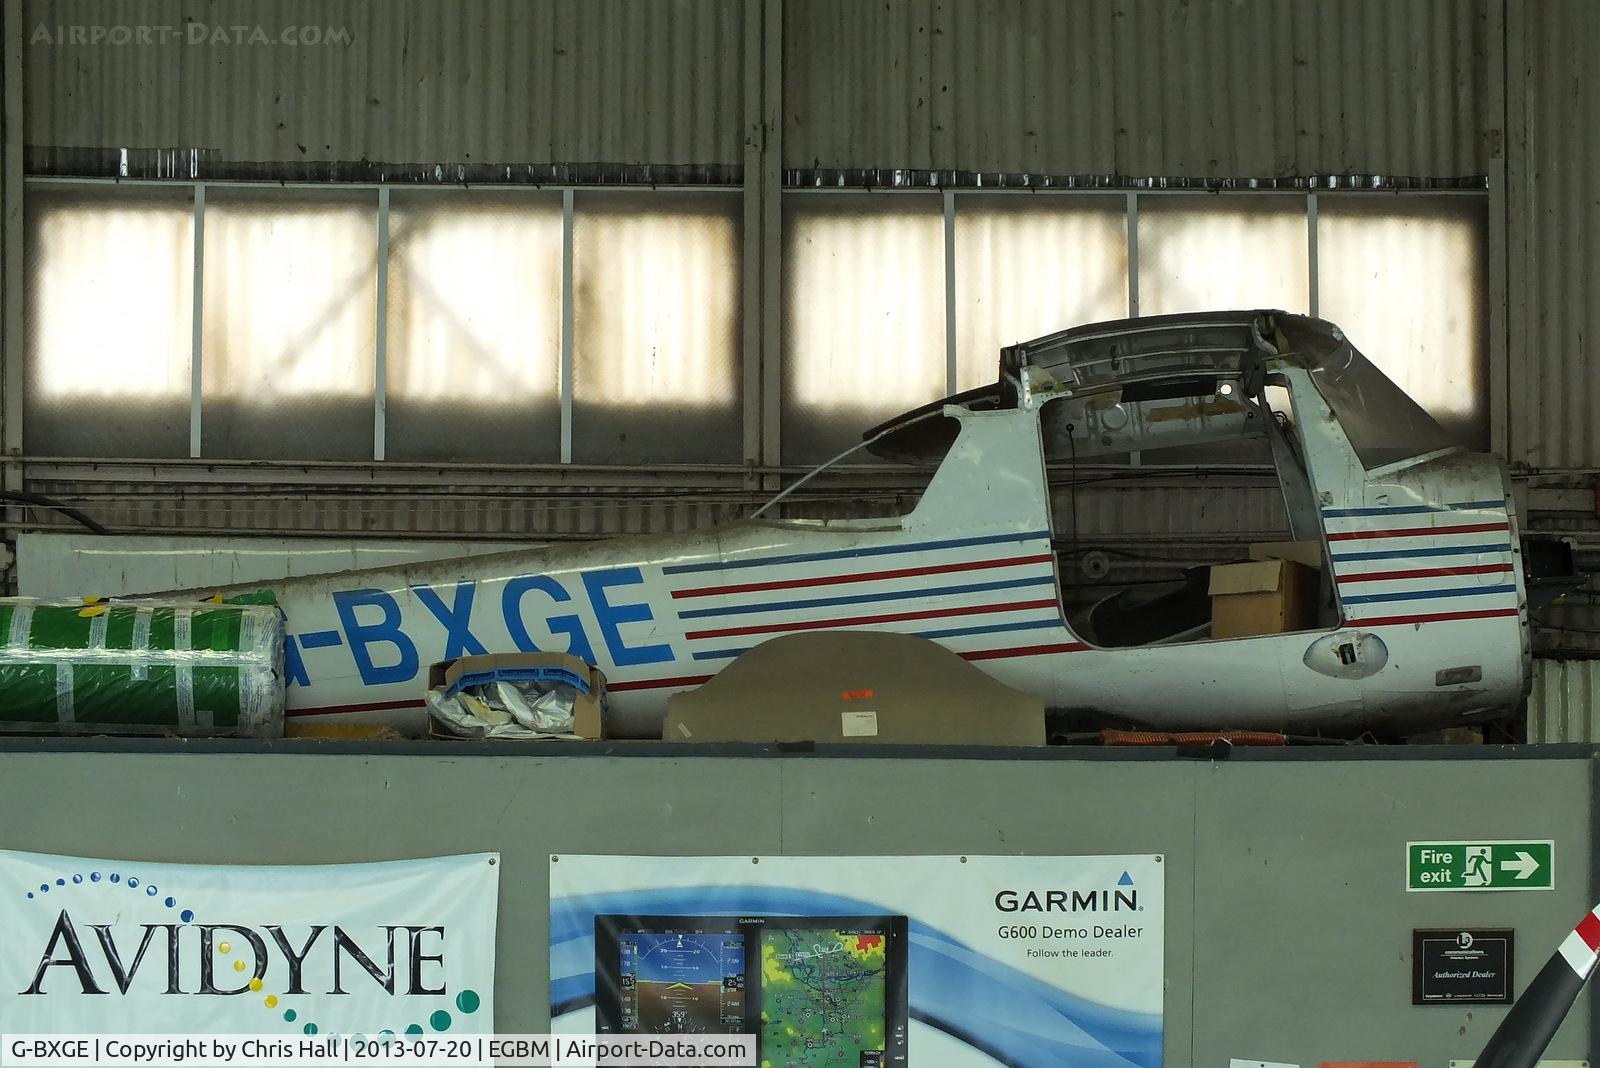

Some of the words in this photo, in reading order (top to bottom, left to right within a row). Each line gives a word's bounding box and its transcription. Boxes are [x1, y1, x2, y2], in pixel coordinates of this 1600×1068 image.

[1420, 849, 1453, 864] Fire
[1420, 868, 1452, 883] exit
[995, 890, 1137, 912] GARMIN
[998, 926, 1037, 939] G600
[1042, 926, 1088, 939] Demo
[1093, 925, 1144, 938] Dealer
[18, 908, 447, 996] AVIDYNE
[1027, 949, 1059, 958] Follow
[1062, 949, 1078, 958] the
[1081, 949, 1114, 958] leader.
[1432, 970, 1471, 979] Authorized
[1472, 970, 1496, 978] Dealer
